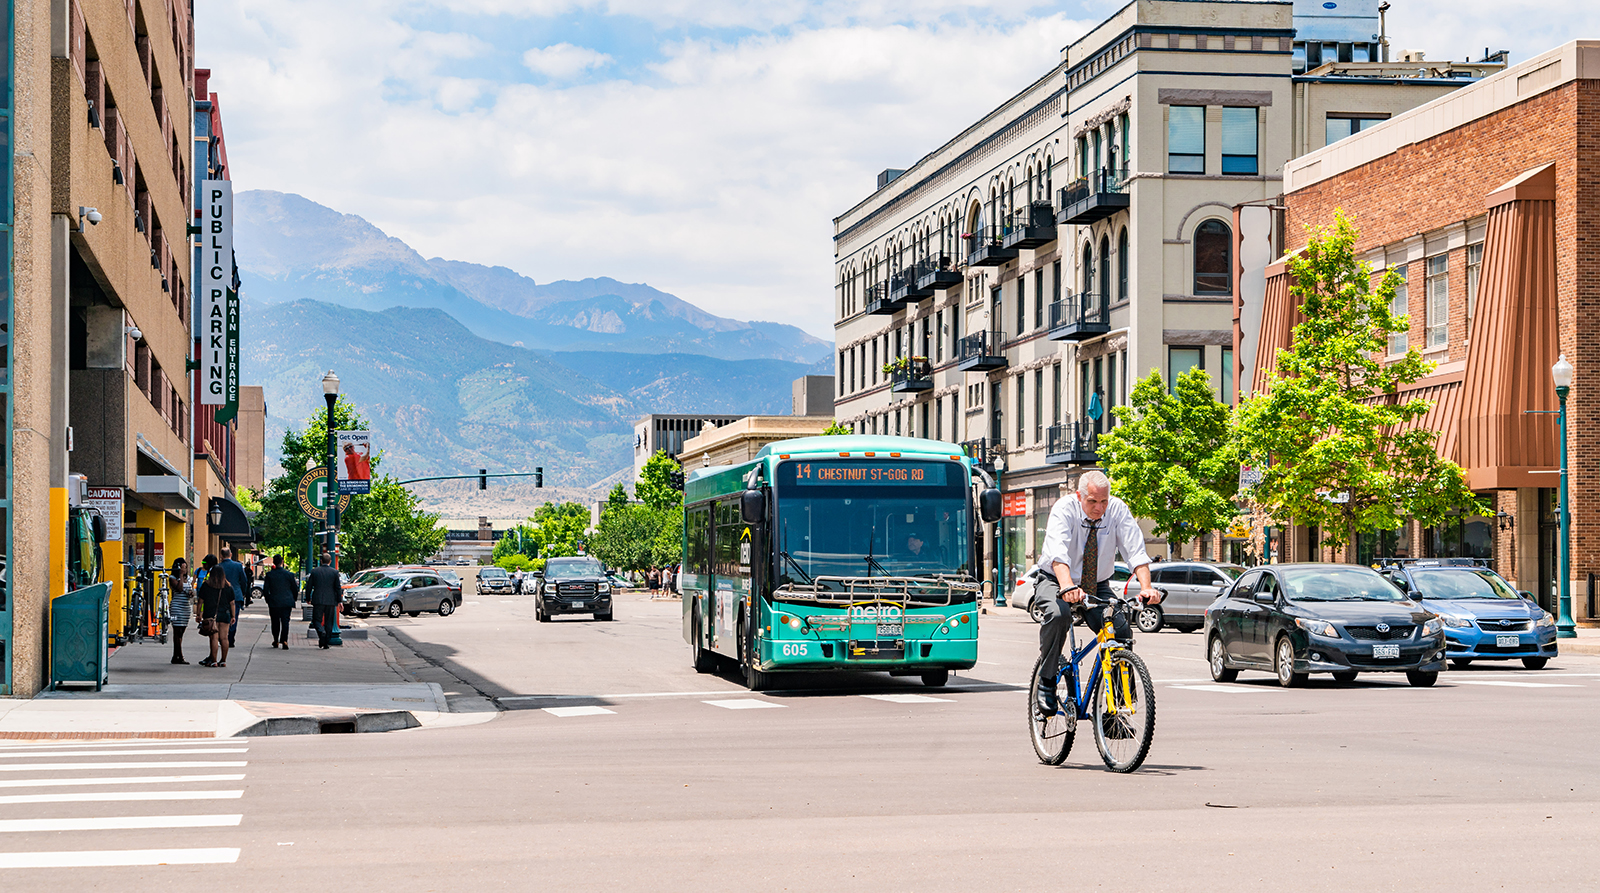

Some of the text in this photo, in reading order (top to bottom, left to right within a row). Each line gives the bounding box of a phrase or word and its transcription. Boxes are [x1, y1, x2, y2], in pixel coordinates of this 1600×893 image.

[209, 189, 223, 395] PUBLIC PARKING
[229, 300, 237, 331] MAIN
[796, 463, 924, 480] 14 CHESTNUT ST-GOG RD
[1241, 471, 1260, 479] FIRST
[88, 490, 120, 498] CAUTION
[299, 494, 320, 517] PUBLIC
[847, 603, 901, 619] metro
[782, 643, 808, 656] 605
